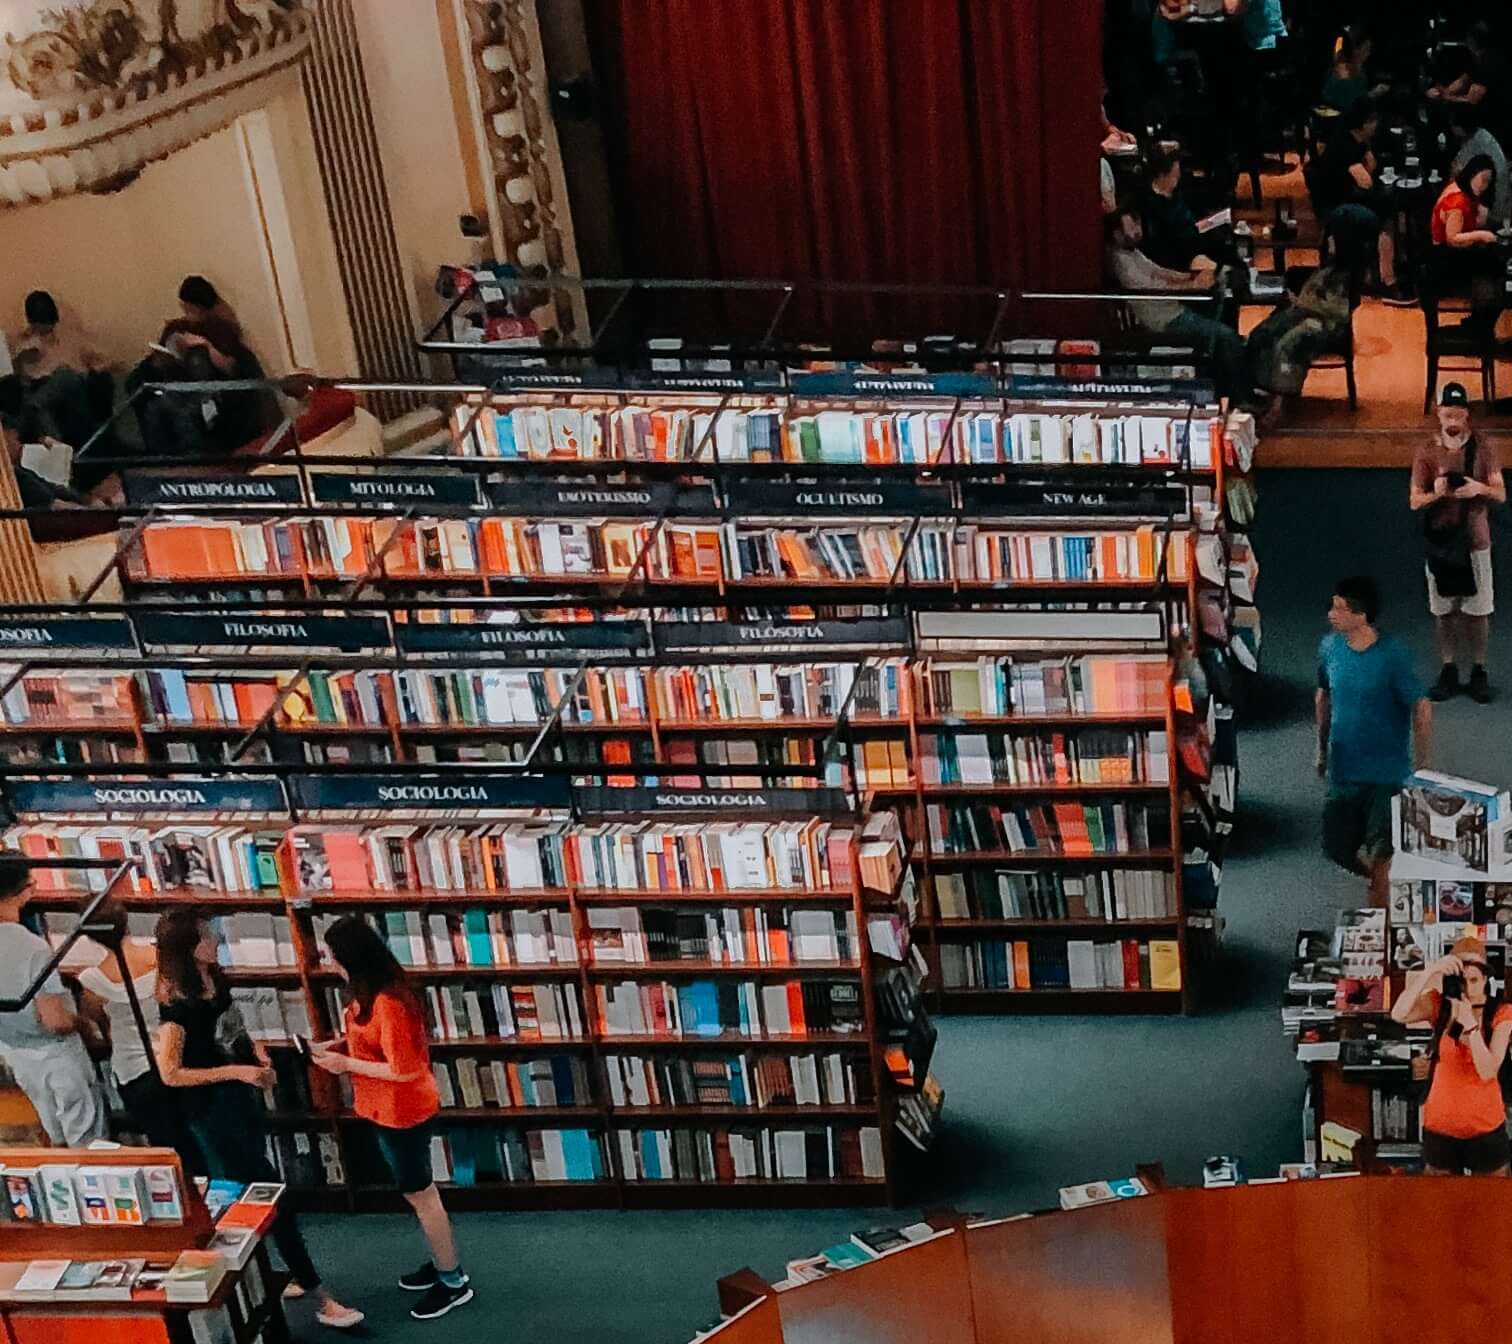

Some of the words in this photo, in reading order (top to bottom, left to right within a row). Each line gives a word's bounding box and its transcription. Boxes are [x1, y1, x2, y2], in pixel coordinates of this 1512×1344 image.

[159, 483, 277, 497] ANTROPOLOGIA
[350, 482, 436, 497] MITOLOGIA
[795, 491, 884, 505] OCULTISMO
[1043, 492, 1074, 505] NEW
[1078, 492, 1107, 505] AGE
[0, 627, 53, 642] OSOFIA
[224, 621, 308, 638] FILOSOFIA
[480, 630, 566, 643] FILOSOFIA
[739, 624, 824, 640] FILOSOFIA
[94, 788, 206, 804] SOCIOLOGIA
[377, 784, 489, 802] SOCIOLOGIA
[655, 792, 767, 806] SOCIOLOGIA
